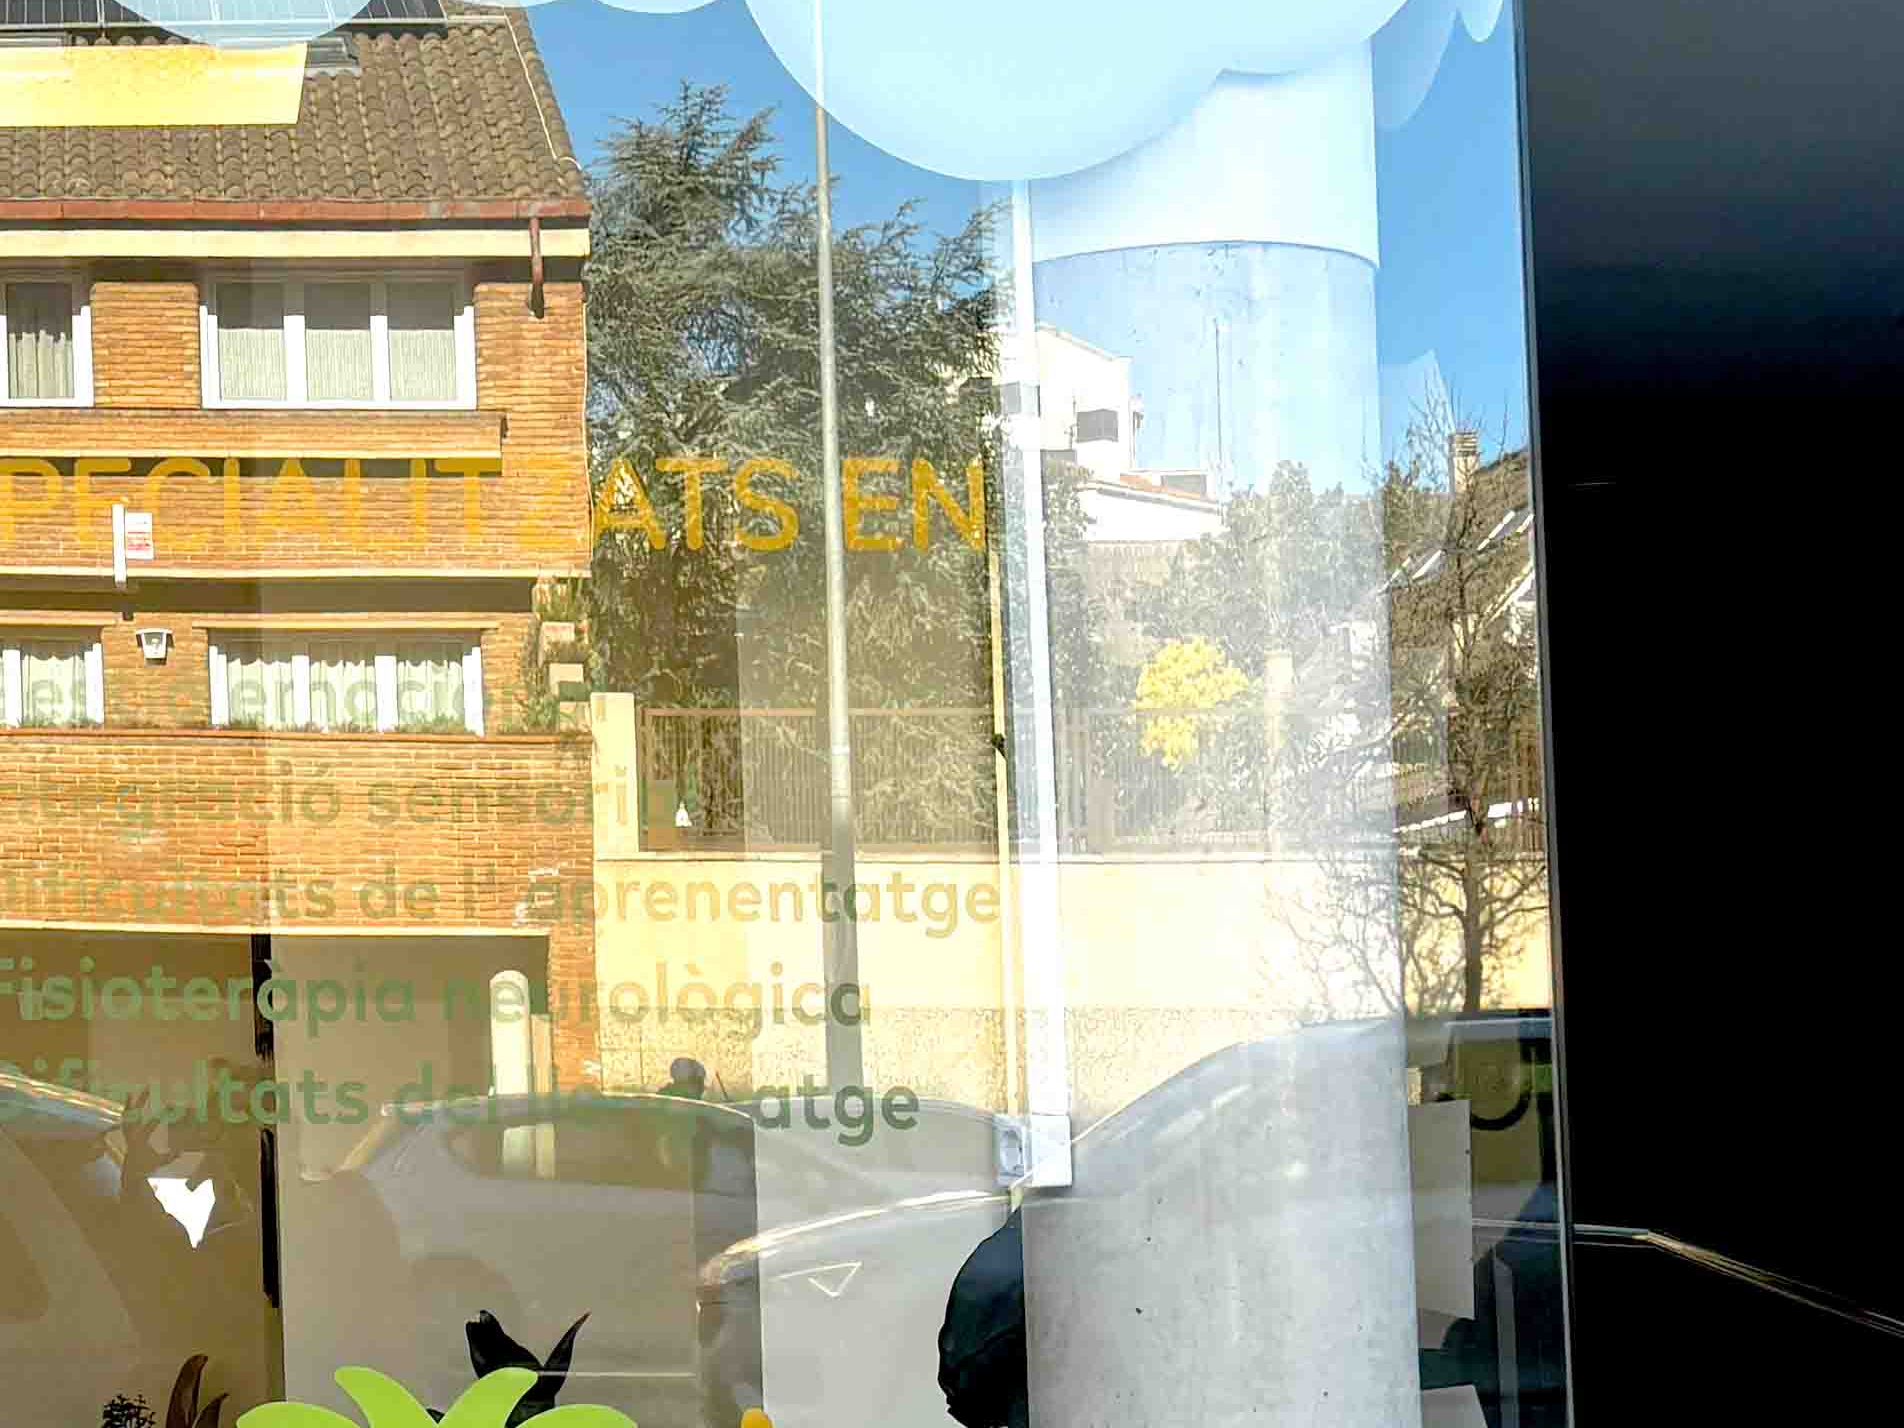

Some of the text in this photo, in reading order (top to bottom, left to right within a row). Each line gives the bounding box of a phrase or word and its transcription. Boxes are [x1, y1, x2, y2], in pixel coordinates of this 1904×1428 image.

[842, 457, 986, 552] EN
[366, 758, 700, 829] sensoril
[359, 866, 440, 922] de
